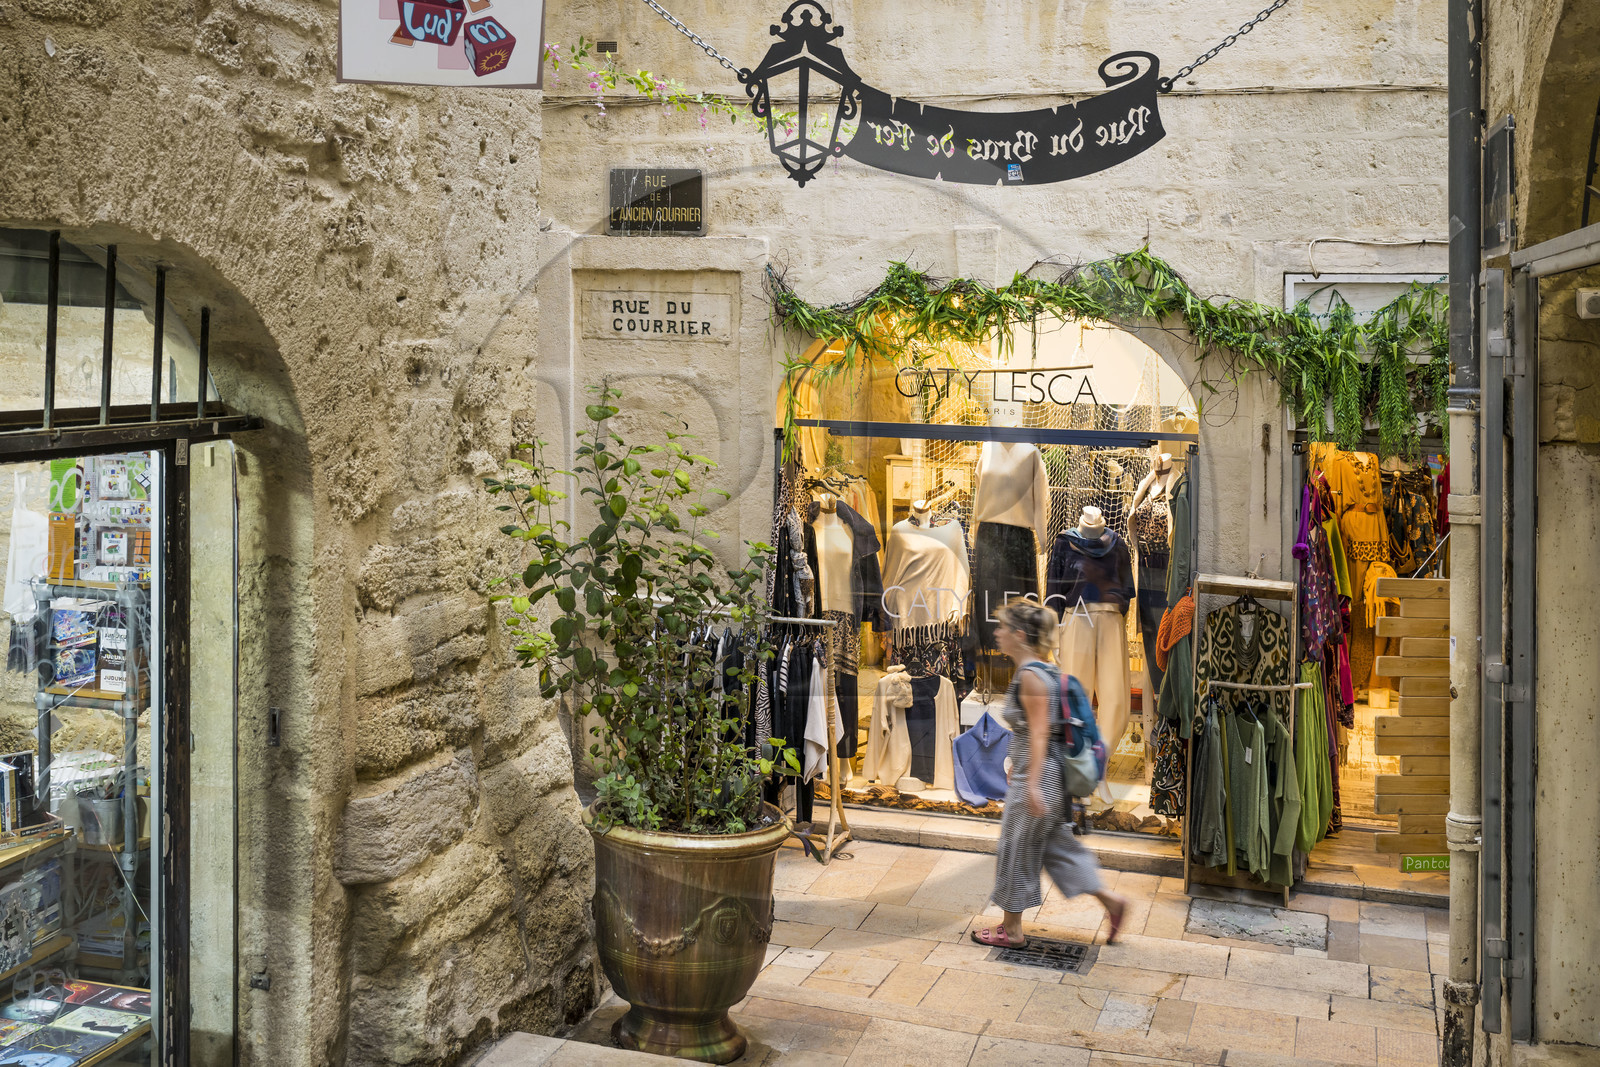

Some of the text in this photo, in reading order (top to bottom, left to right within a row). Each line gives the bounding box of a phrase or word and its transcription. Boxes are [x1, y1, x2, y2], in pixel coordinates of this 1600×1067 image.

[644, 175, 667, 188] RUE
[650, 192, 661, 202] DE
[655, 207, 702, 223] COURRIER
[612, 300, 691, 315] RUE DU
[613, 318, 712, 336] COURRIER
[894, 367, 1099, 406] CATY LESCA
[974, 407, 1016, 416] PARIS
[881, 585, 972, 620] CATY
